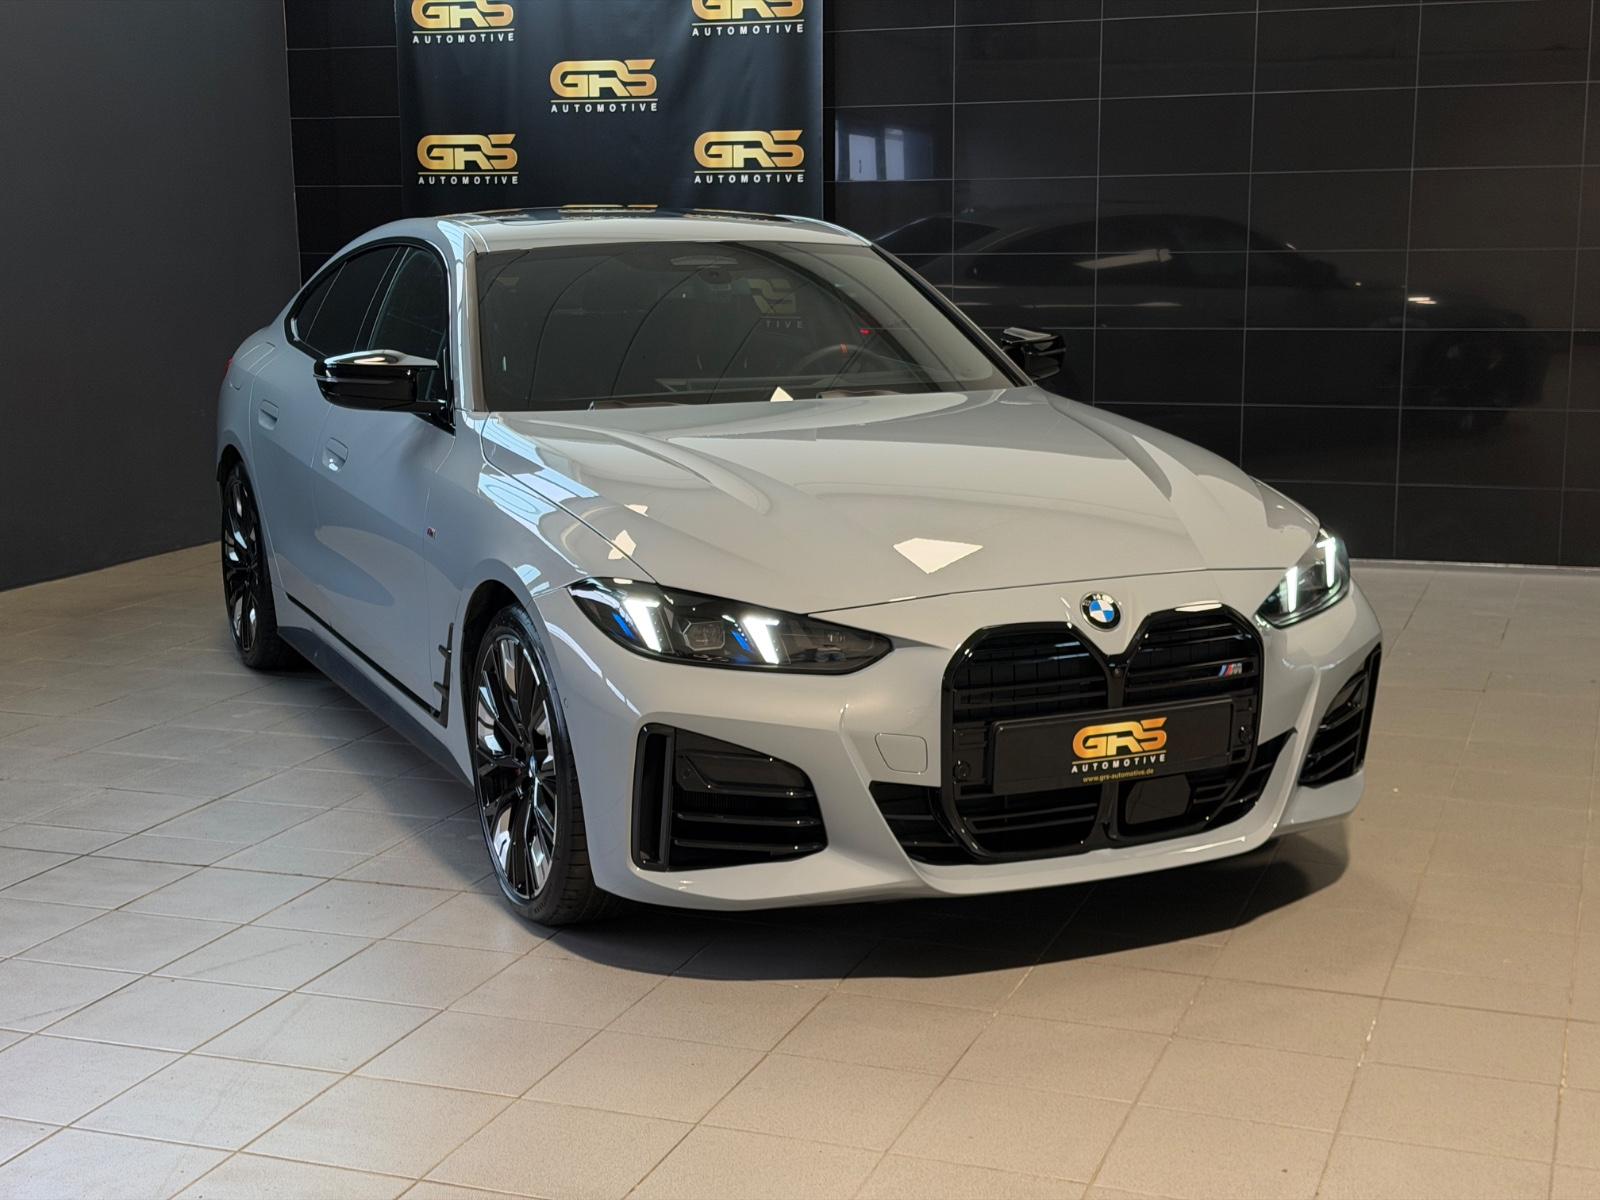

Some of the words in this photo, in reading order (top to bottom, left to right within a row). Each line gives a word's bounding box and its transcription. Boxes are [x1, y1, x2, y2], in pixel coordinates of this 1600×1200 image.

[411, 0, 514, 29] GRS
[412, 32, 514, 44] AUTOMOTIVE
[691, 24, 804, 37] AUTOMOTIVE
[549, 59, 657, 98] GRS
[550, 103, 658, 113] AUTOMOTIVE
[416, 133, 518, 171] GRS
[693, 129, 805, 168] GRS
[418, 176, 519, 185] AUTOMOTIVE
[694, 174, 804, 184] AUTOMOTIVE
[1072, 716, 1168, 760] GRS
[1071, 754, 1166, 774] AUTOMOTIVE
[1082, 767, 1155, 783] www.grs-automotive.de
